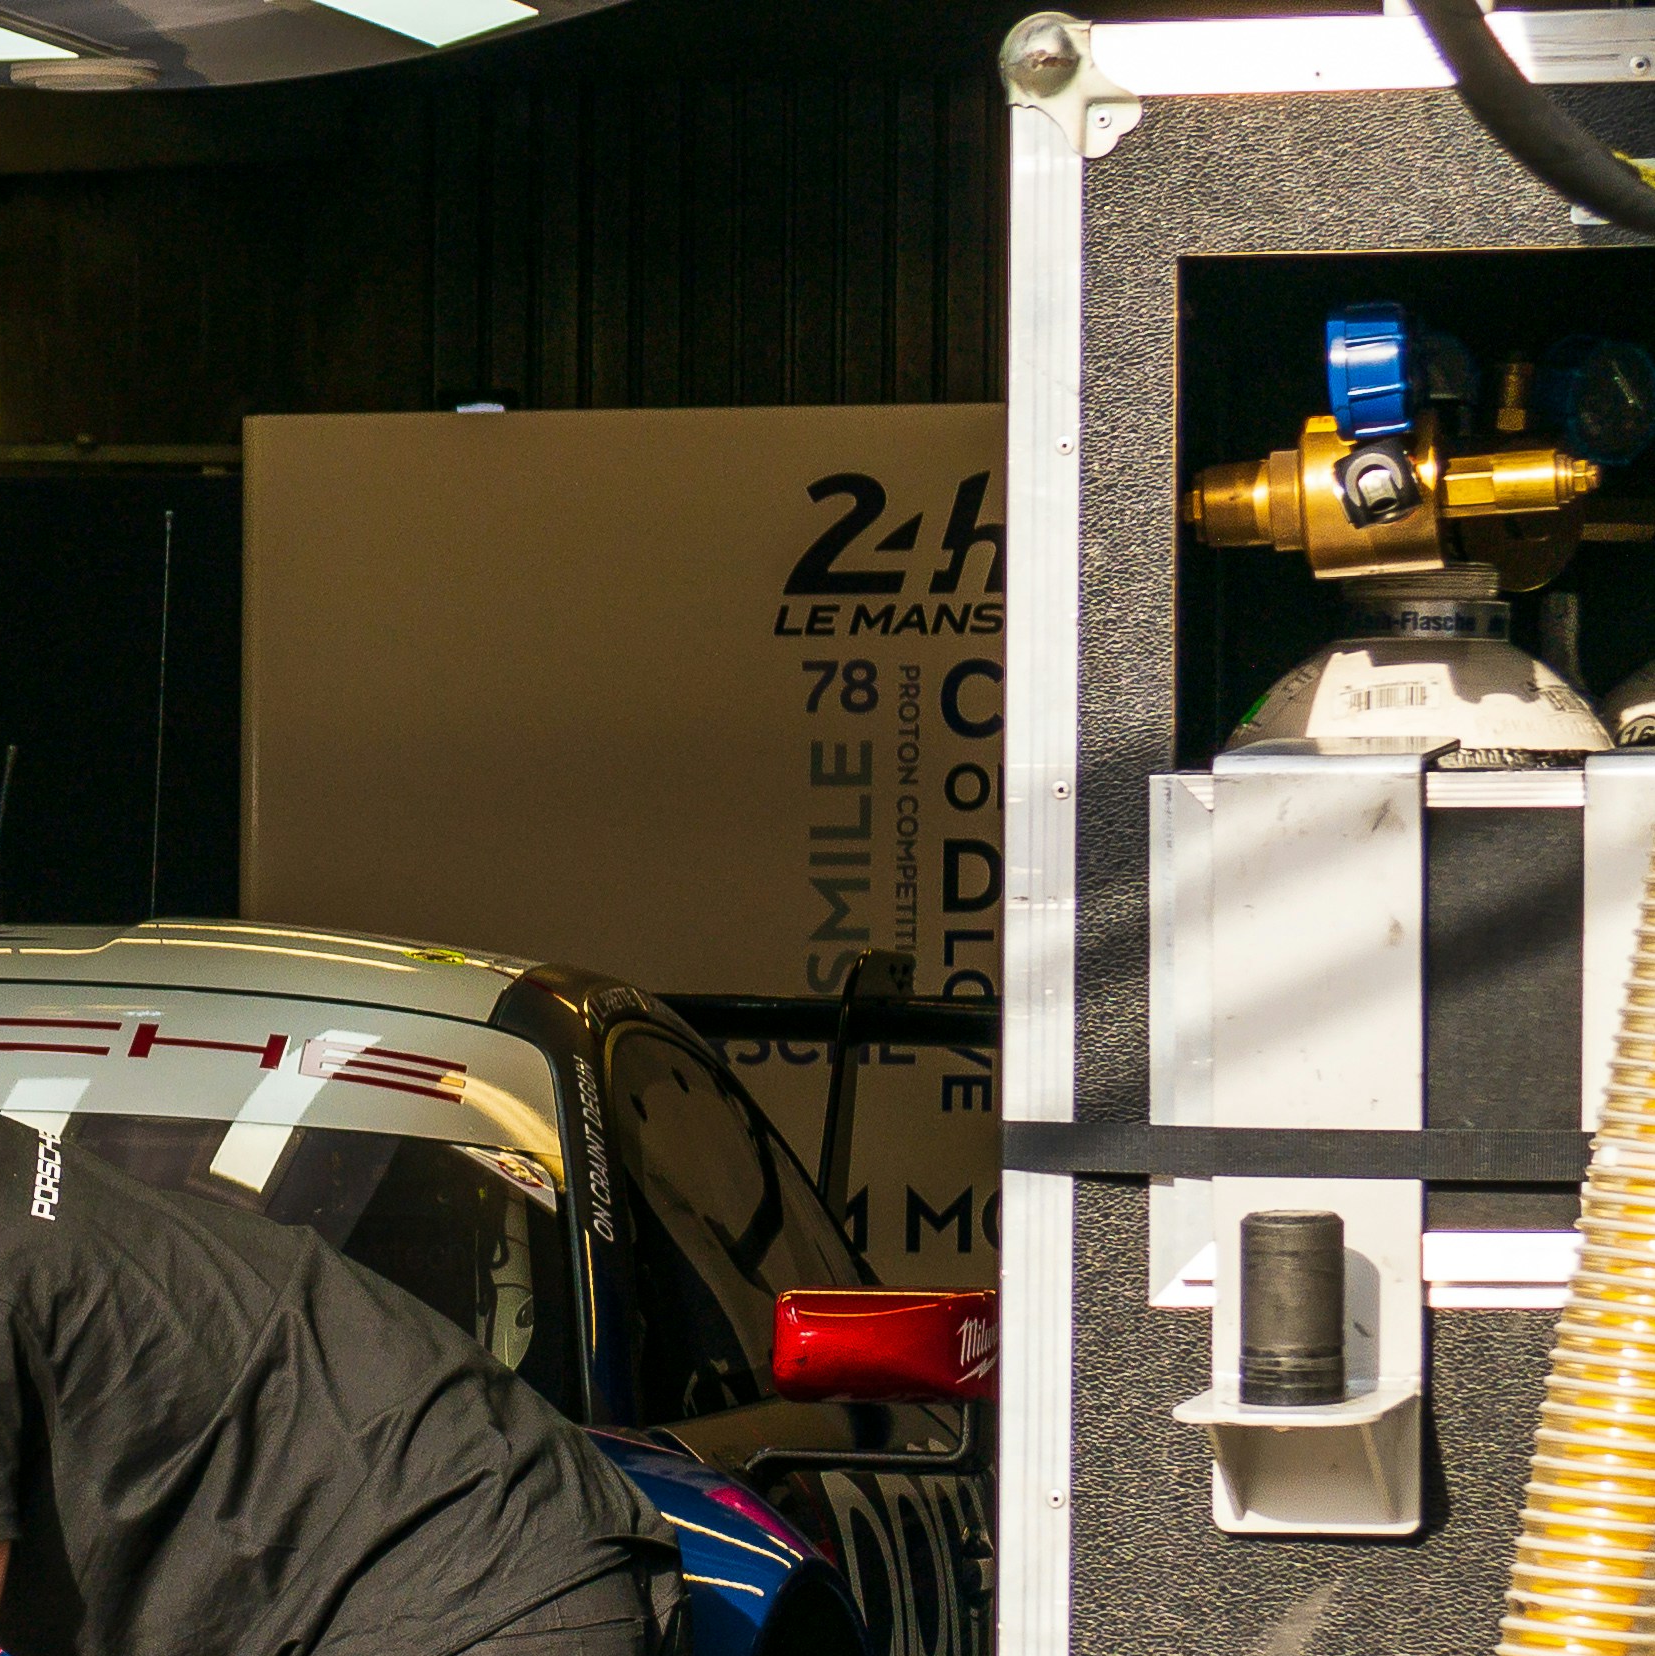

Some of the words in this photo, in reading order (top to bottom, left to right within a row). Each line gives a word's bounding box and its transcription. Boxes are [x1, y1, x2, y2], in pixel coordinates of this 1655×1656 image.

[774, 604, 840, 636] LE
[849, 603, 1005, 636] MANS
[802, 659, 879, 714] 78
[897, 664, 921, 787] PROTON
[944, 762, 1005, 812] O
[806, 740, 874, 993] SMILE
[895, 797, 921, 951] COMPETITI
[593, 1206, 615, 1243] ON
